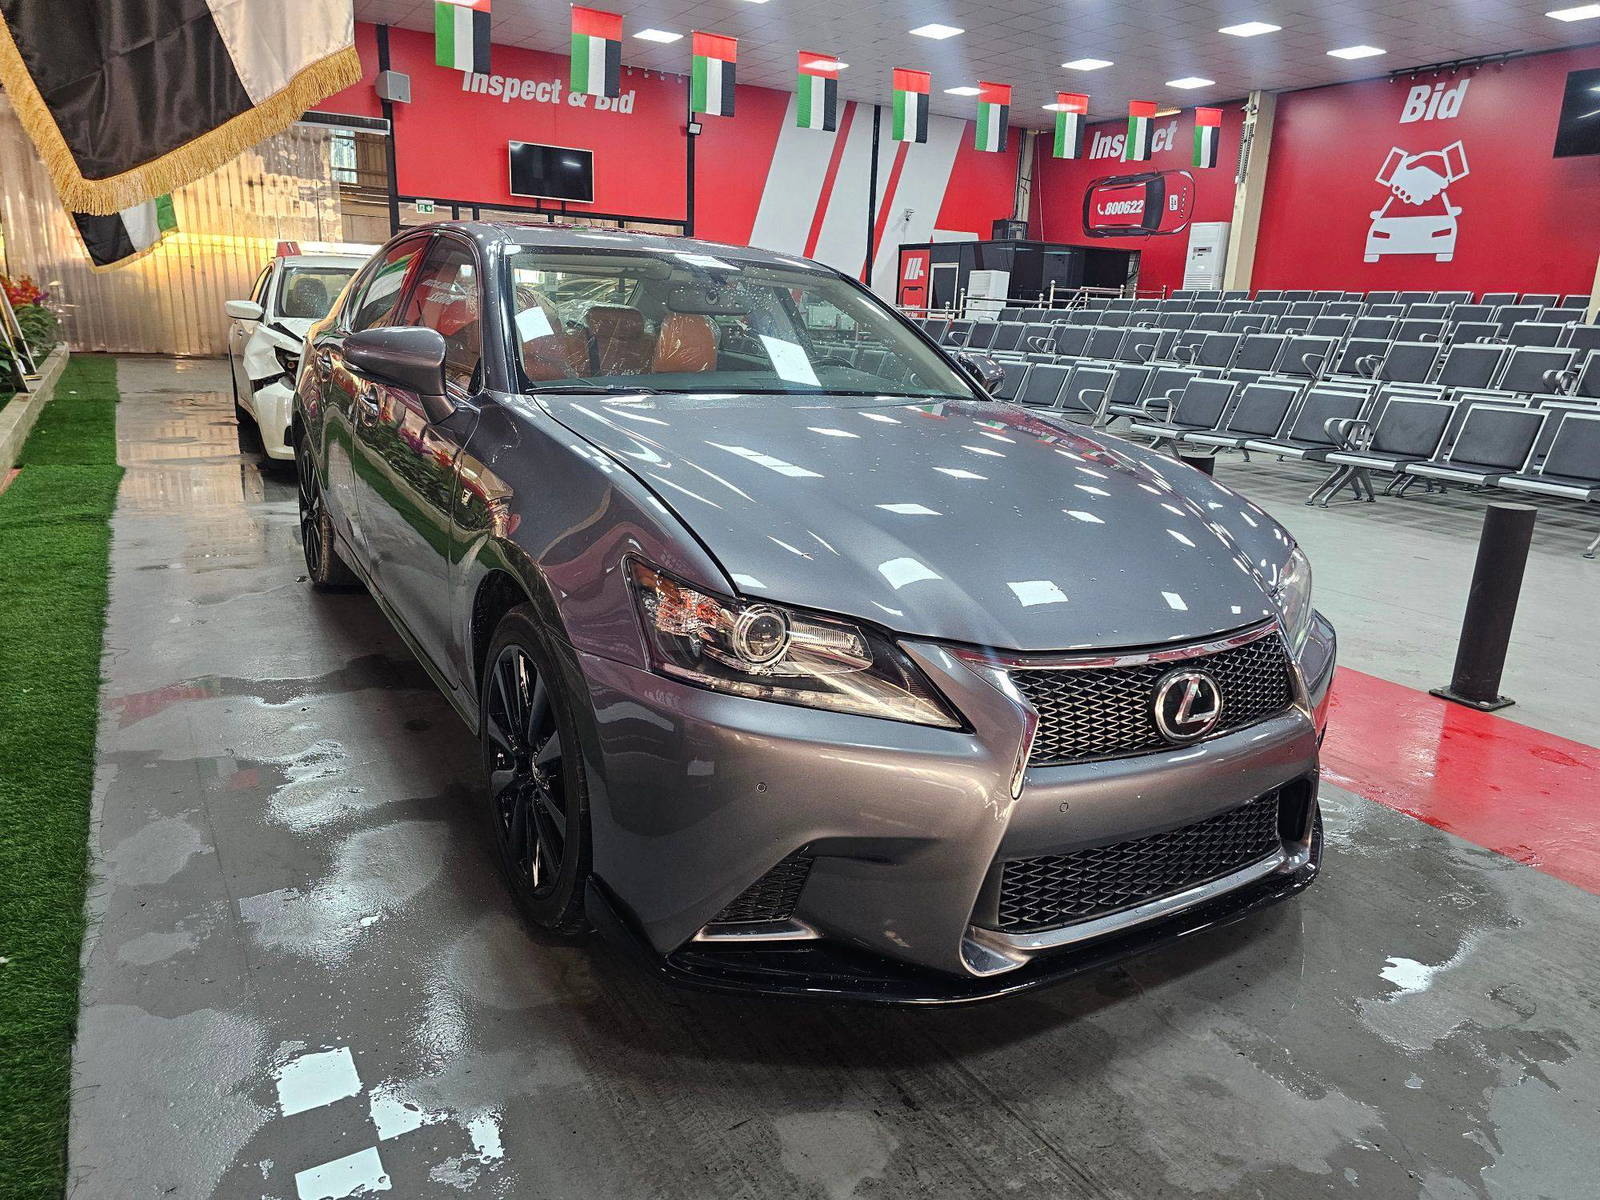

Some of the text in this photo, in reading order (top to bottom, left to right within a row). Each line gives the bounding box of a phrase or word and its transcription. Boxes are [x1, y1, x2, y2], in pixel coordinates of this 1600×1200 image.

[462, 72, 562, 104] Inspect
[567, 91, 586, 108] &
[1399, 78, 1471, 124] Bid
[1089, 120, 1178, 163] Insct
[1104, 200, 1145, 215] 800622
